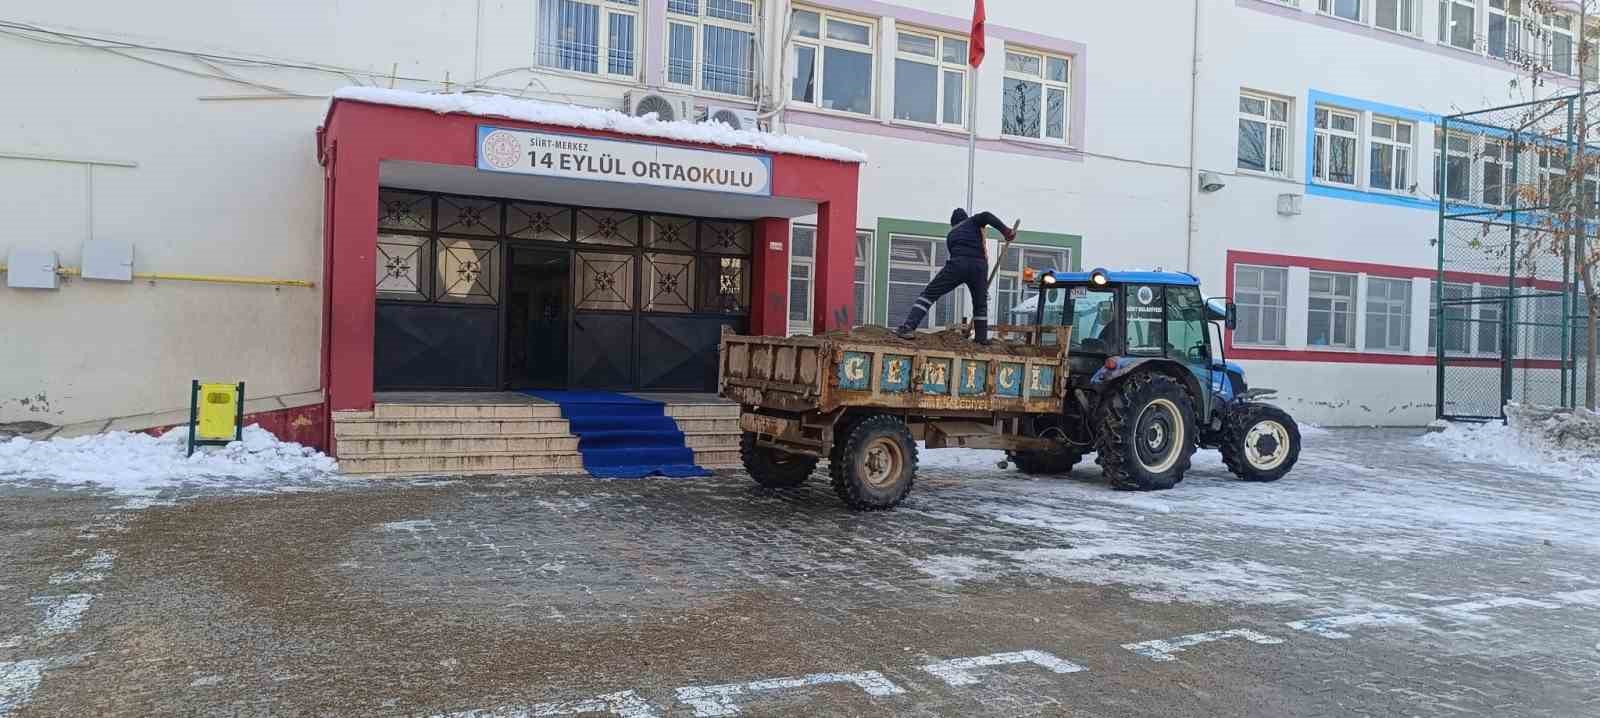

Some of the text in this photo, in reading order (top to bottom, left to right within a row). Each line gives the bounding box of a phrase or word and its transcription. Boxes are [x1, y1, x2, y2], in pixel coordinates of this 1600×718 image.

[528, 150, 753, 188] 14 EYLÜL ORTAOKULU
